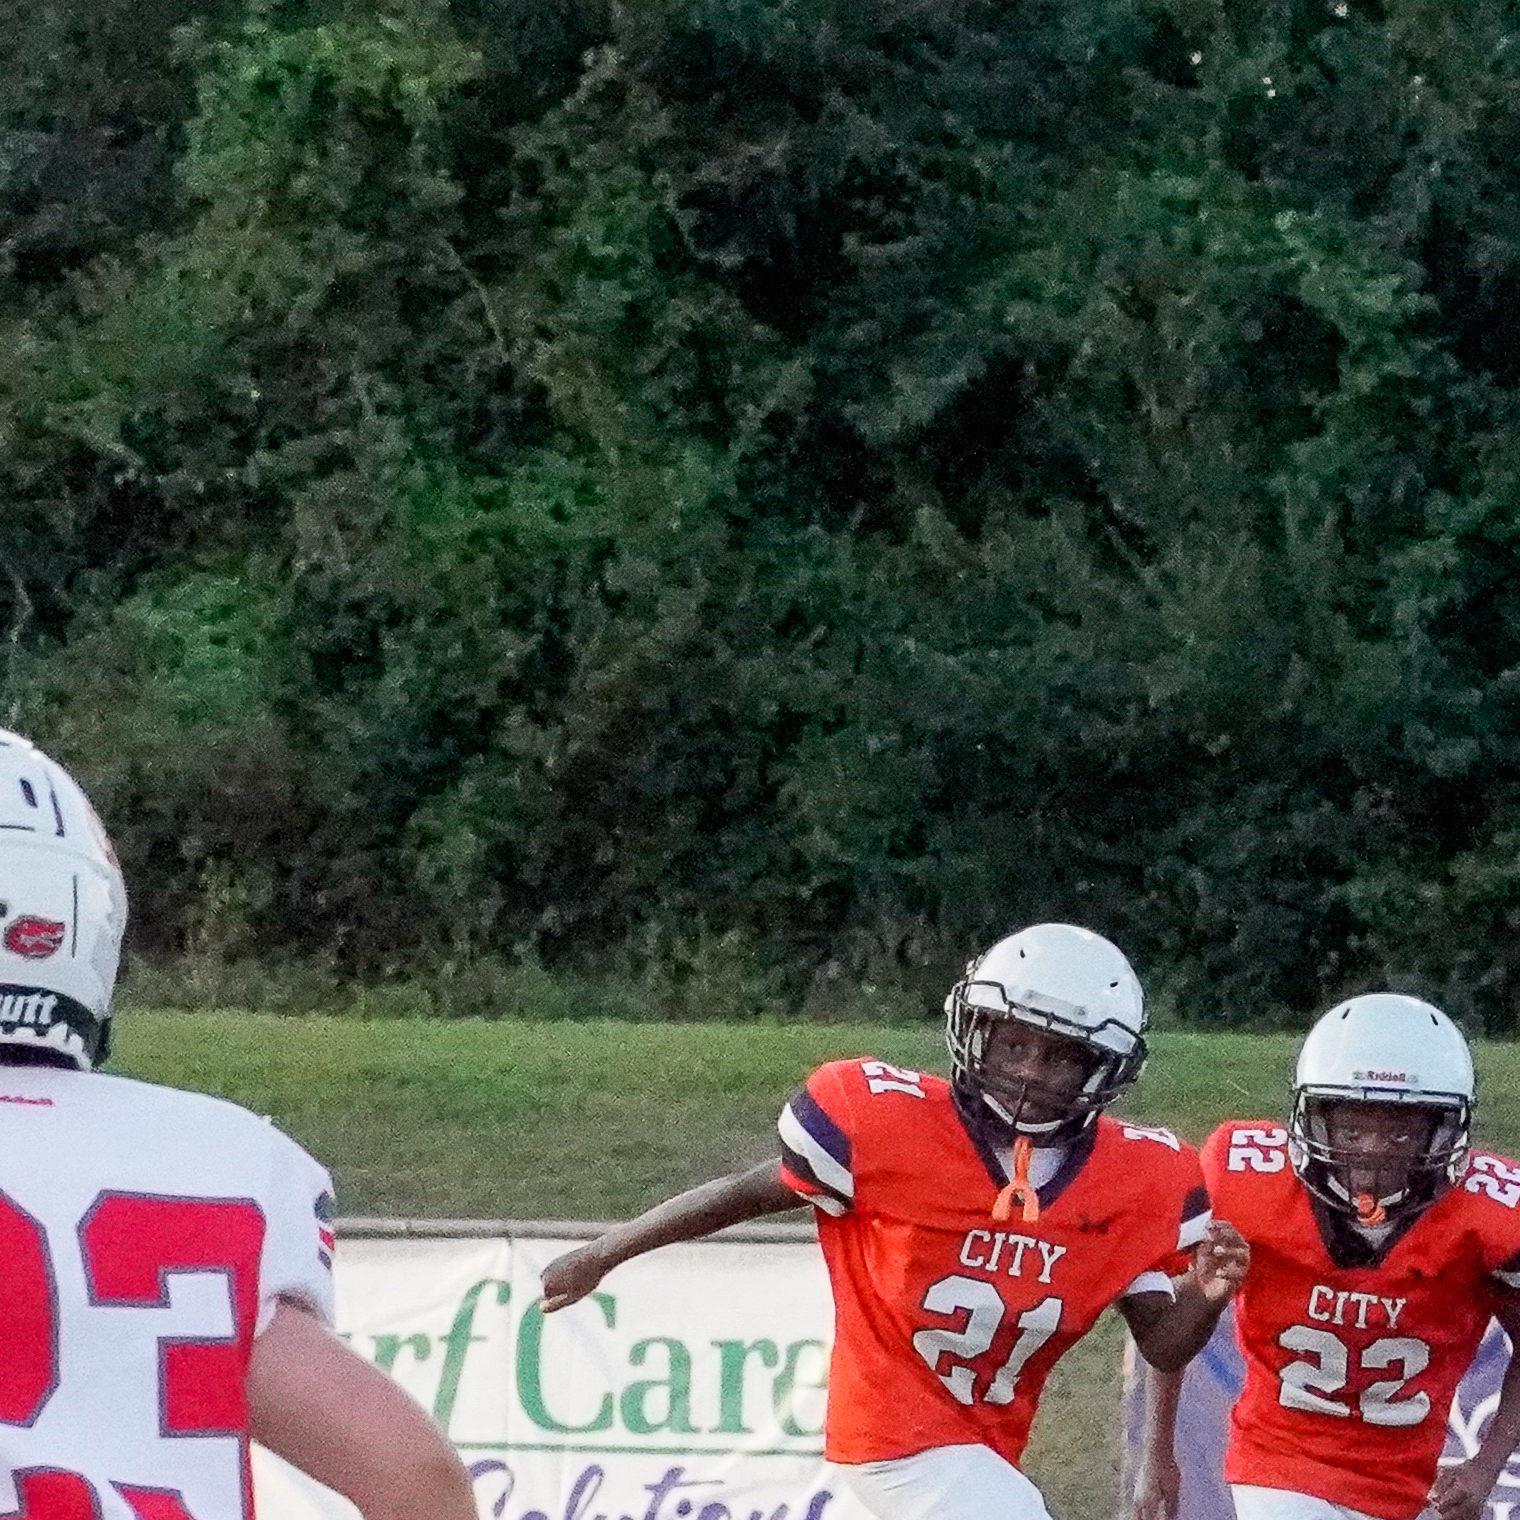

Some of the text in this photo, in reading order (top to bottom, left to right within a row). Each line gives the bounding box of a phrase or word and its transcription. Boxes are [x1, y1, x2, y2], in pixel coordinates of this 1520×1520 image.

[1226, 1128, 1289, 1174] 22
[959, 1228, 1068, 1284] CITY
[911, 1274, 1063, 1405] 21
[1308, 1283, 1407, 1330] CITY
[515, 1291, 829, 1436] Care
[1277, 1324, 1431, 1426] 22
